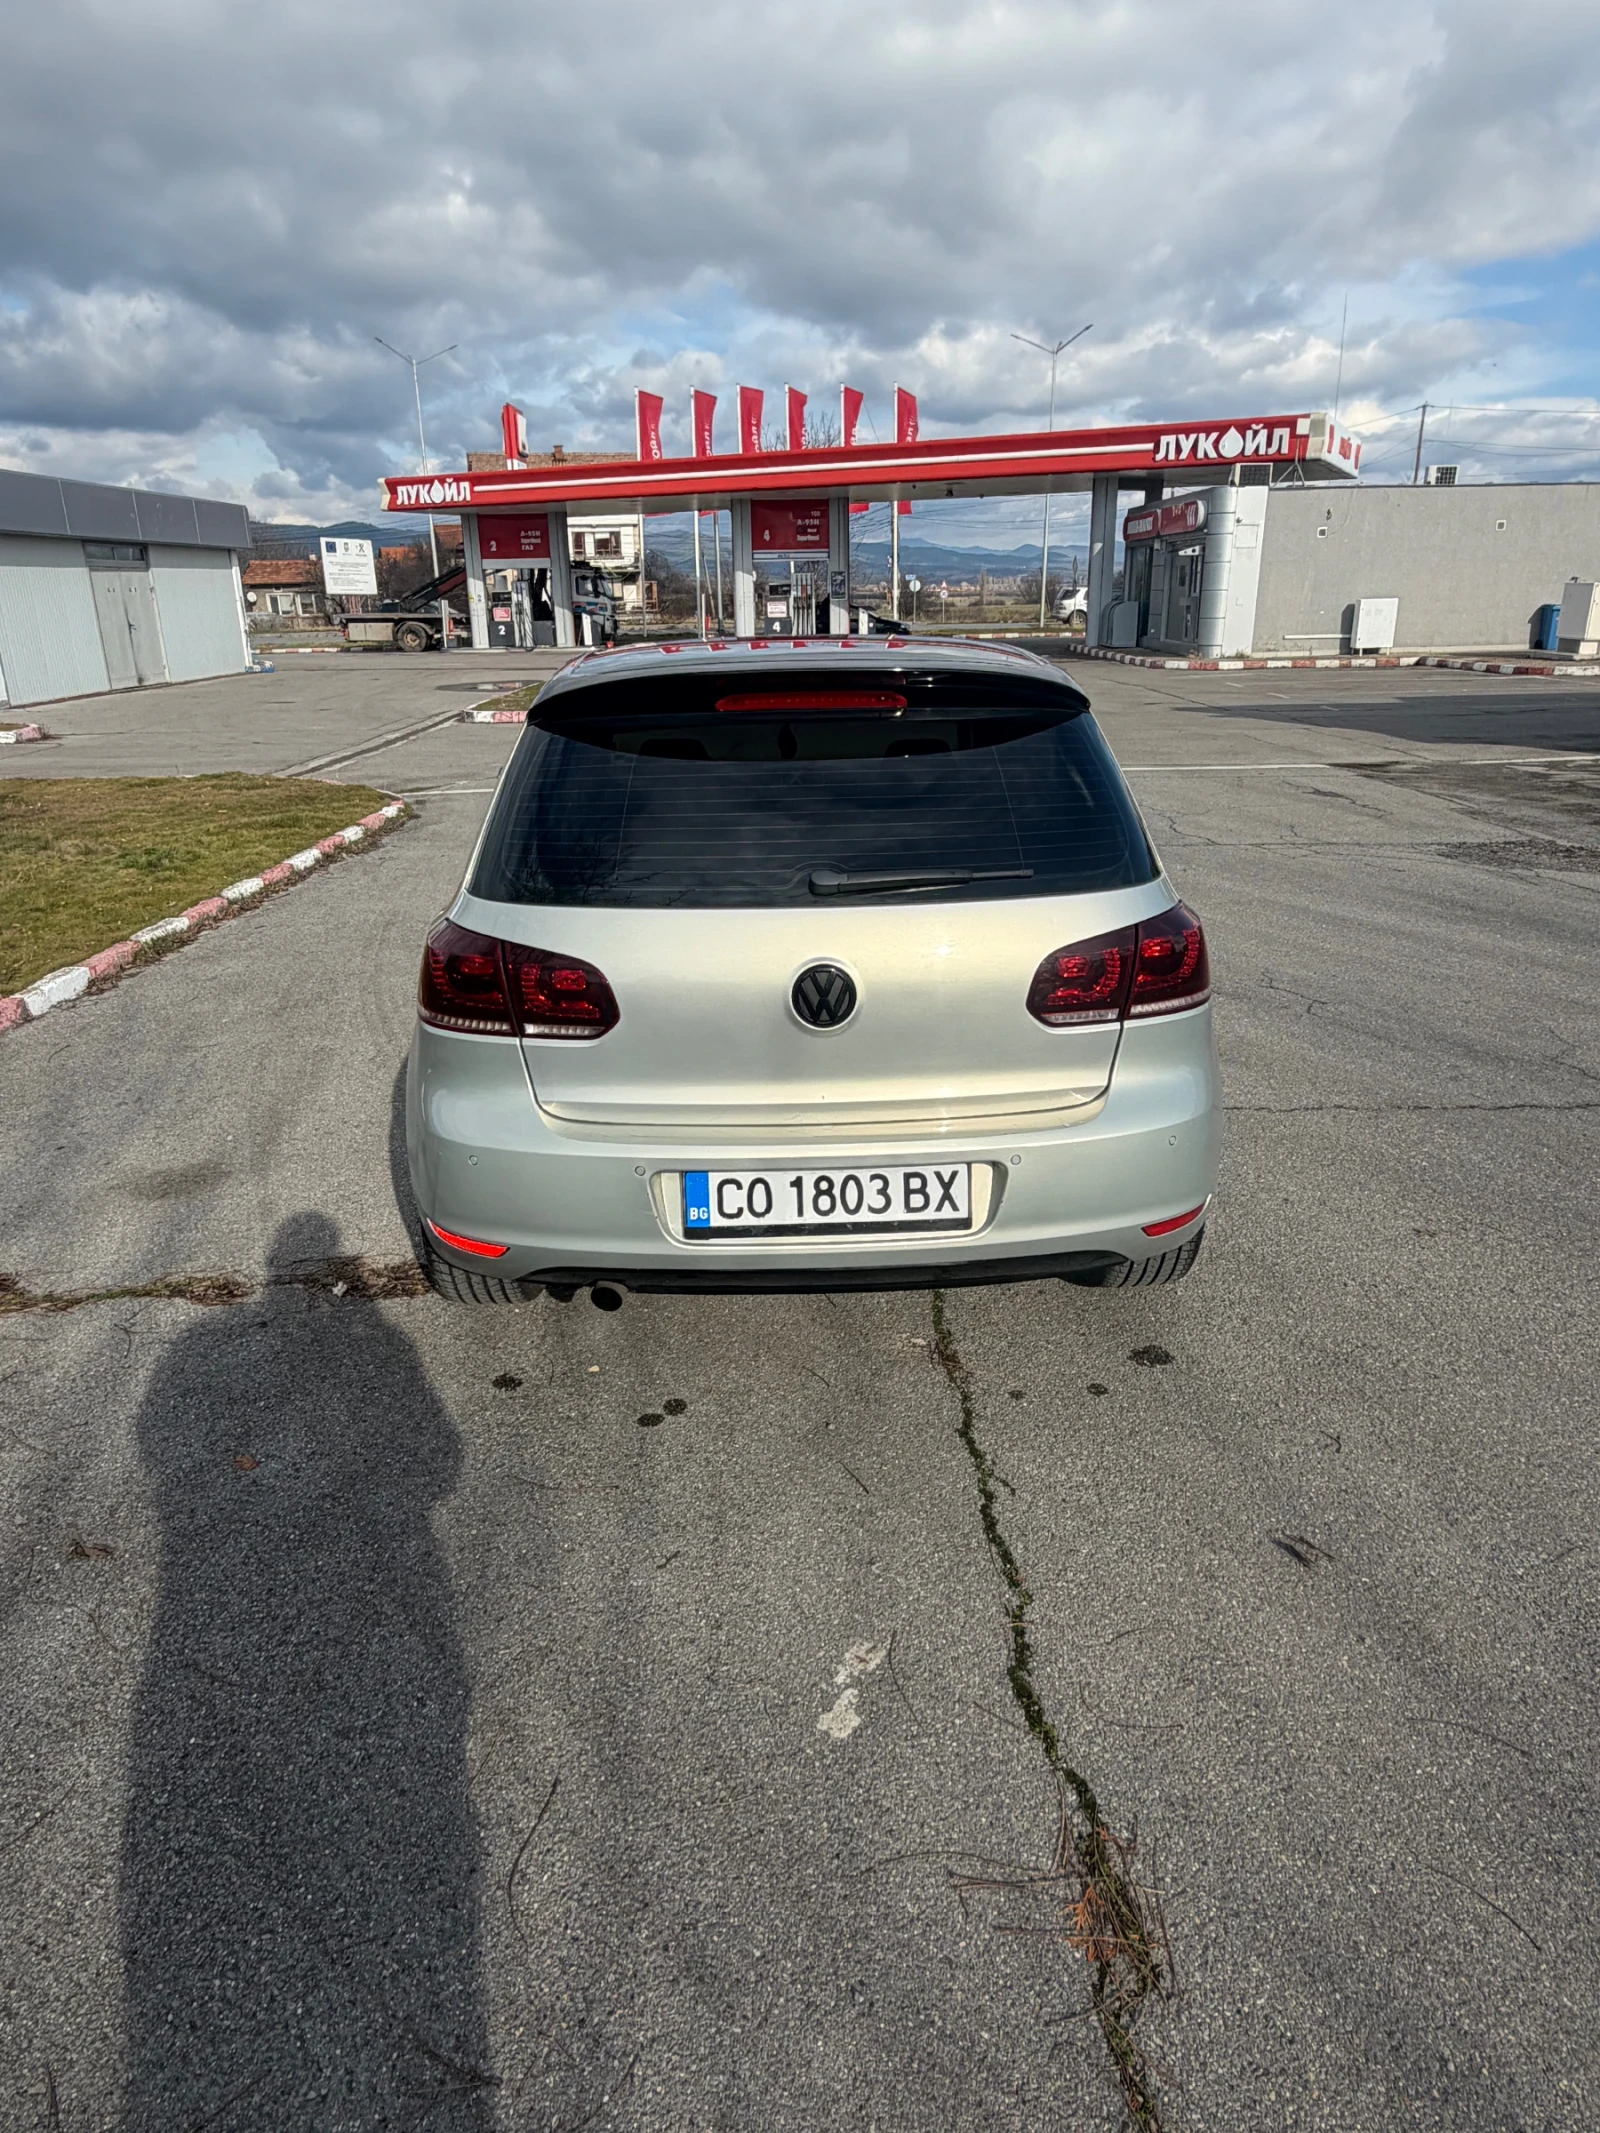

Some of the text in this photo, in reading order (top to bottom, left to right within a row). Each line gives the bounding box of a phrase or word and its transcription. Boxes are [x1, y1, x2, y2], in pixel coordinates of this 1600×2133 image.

[1155, 423, 1290, 461] ЛУКОЙЛ
[396, 478, 471, 505] ЛУКОЙЛ
[489, 540, 498, 552] 2
[498, 625, 506, 635] 2
[772, 621, 781, 632] 4
[789, 1173, 892, 1217] 1803
[903, 1169, 960, 1214] BX
[689, 1207, 709, 1221] BG
